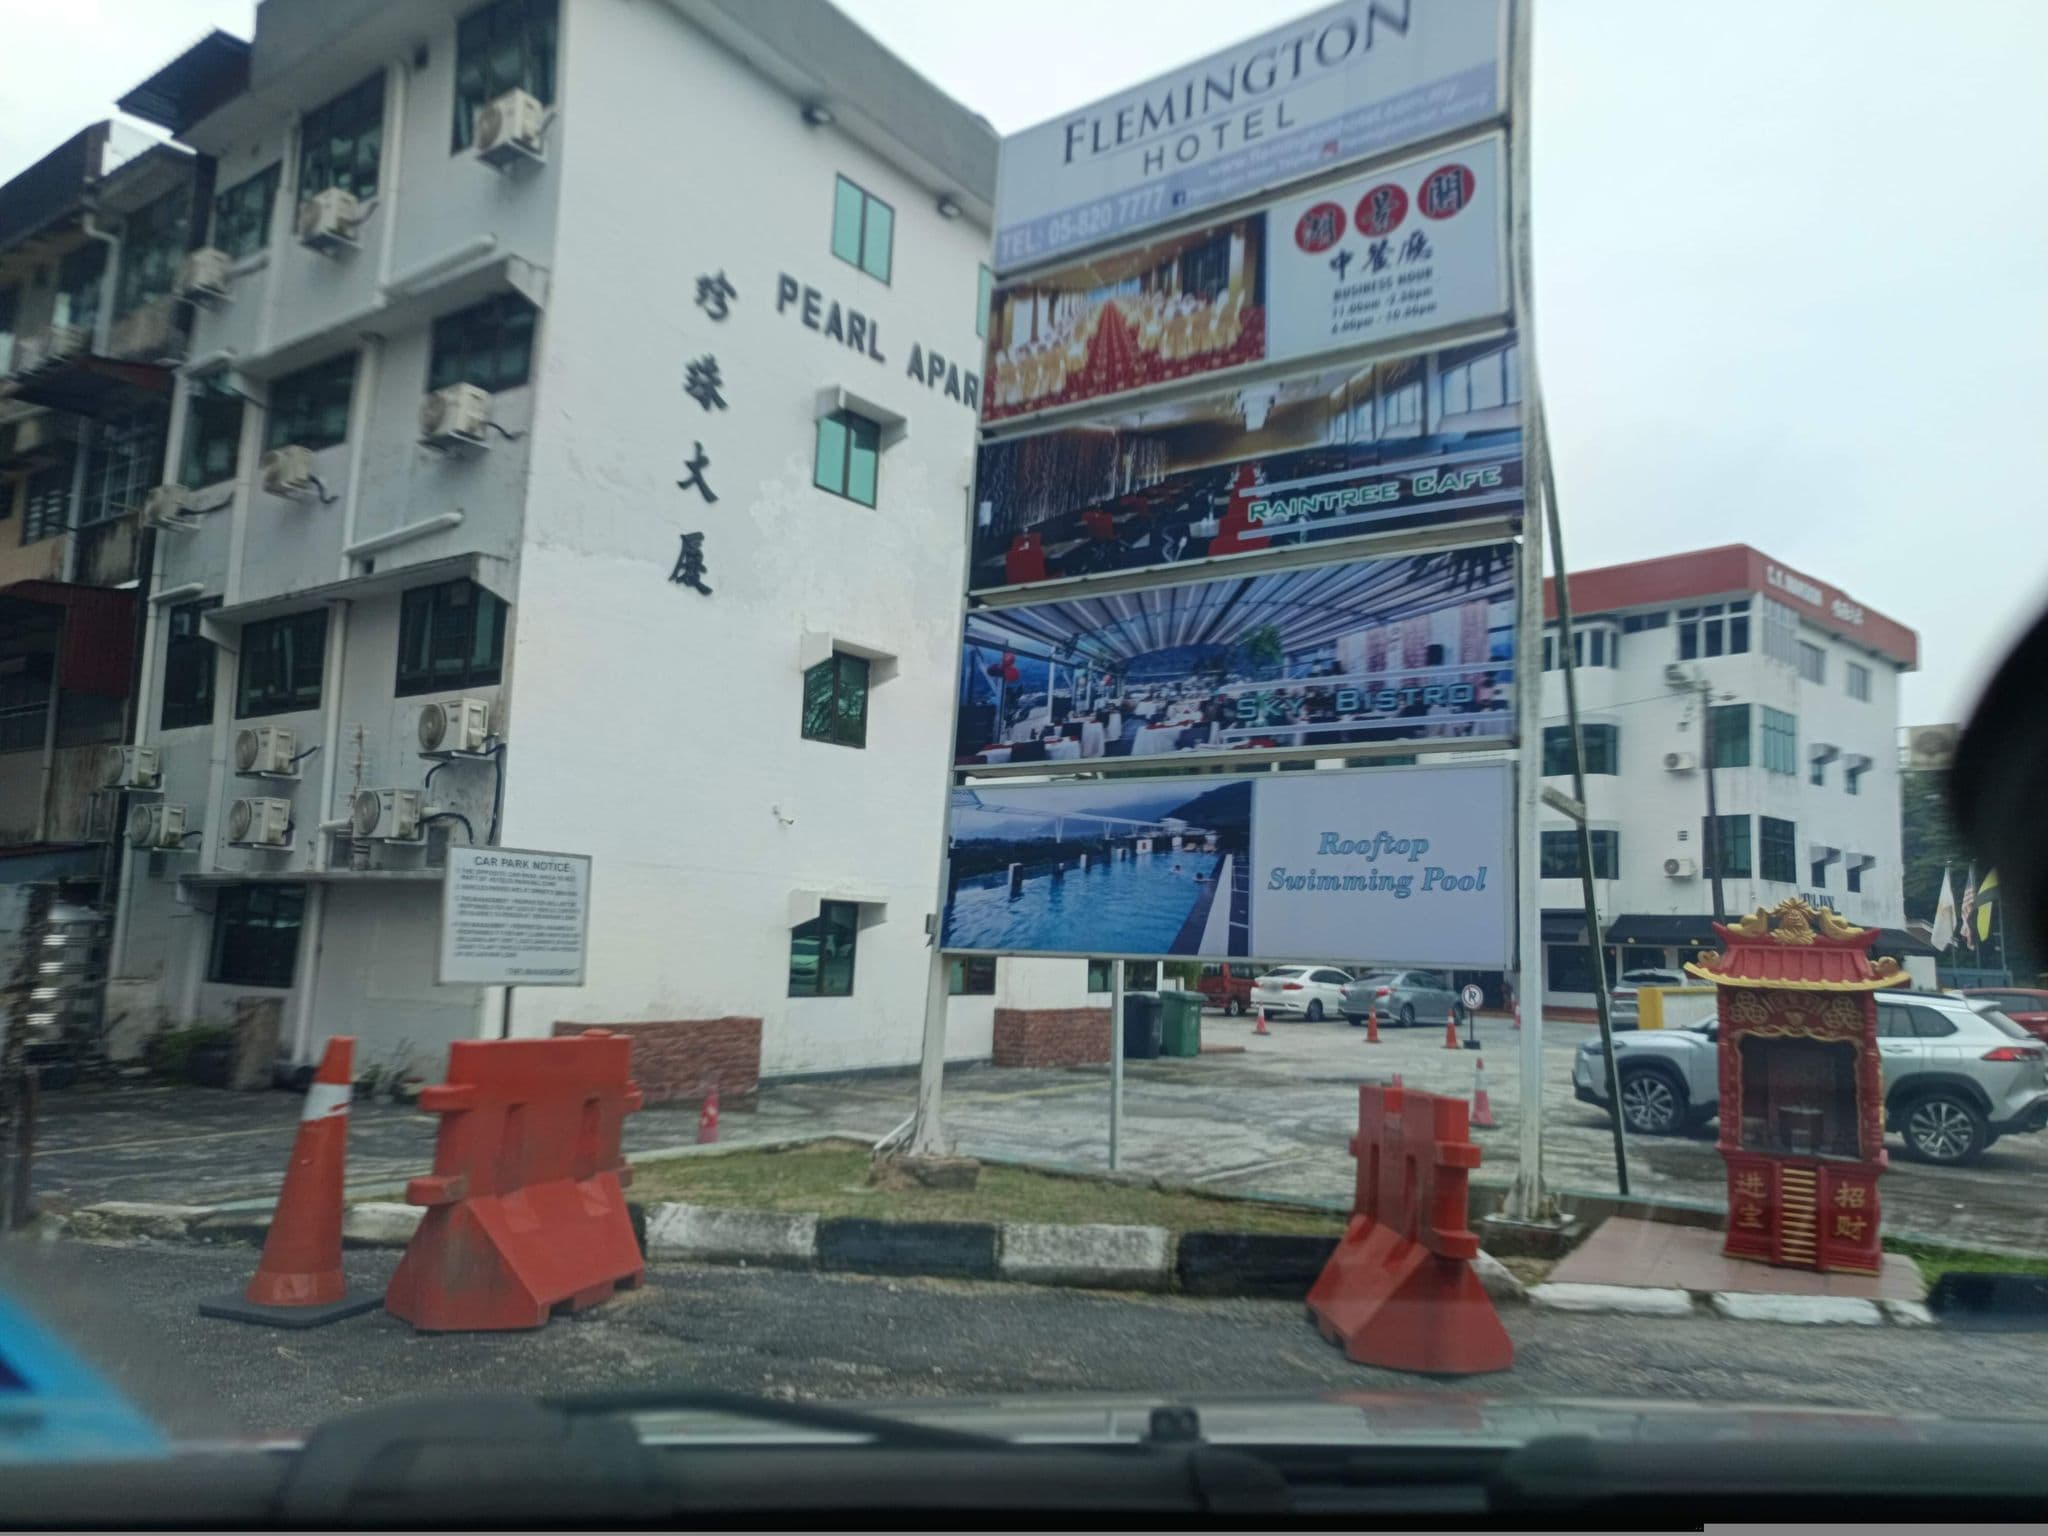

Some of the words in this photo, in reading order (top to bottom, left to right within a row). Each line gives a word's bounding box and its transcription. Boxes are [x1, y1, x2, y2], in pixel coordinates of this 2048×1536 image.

[1063, 0, 1412, 166] FLEMINGTON
[1142, 100, 1296, 178] HOTEL
[1117, 184, 1166, 225] 7777
[1333, 276, 1393, 300] BUSINESS
[775, 271, 886, 364] PEARL
[1248, 481, 1401, 523] RAINTREE
[1411, 465, 1502, 497] CAFE
[1236, 690, 1305, 720] SKY
[474, 855, 498, 867] CAR
[501, 858, 530, 870] PARK
[532, 860, 571, 873] NOTICE
[1317, 830, 1429, 863] Rooftop
[1267, 866, 1413, 899] Swimming
[1420, 865, 1487, 892] Pool
[1734, 1172, 1768, 1229] 进宝
[1834, 1180, 1868, 1242] 招财
